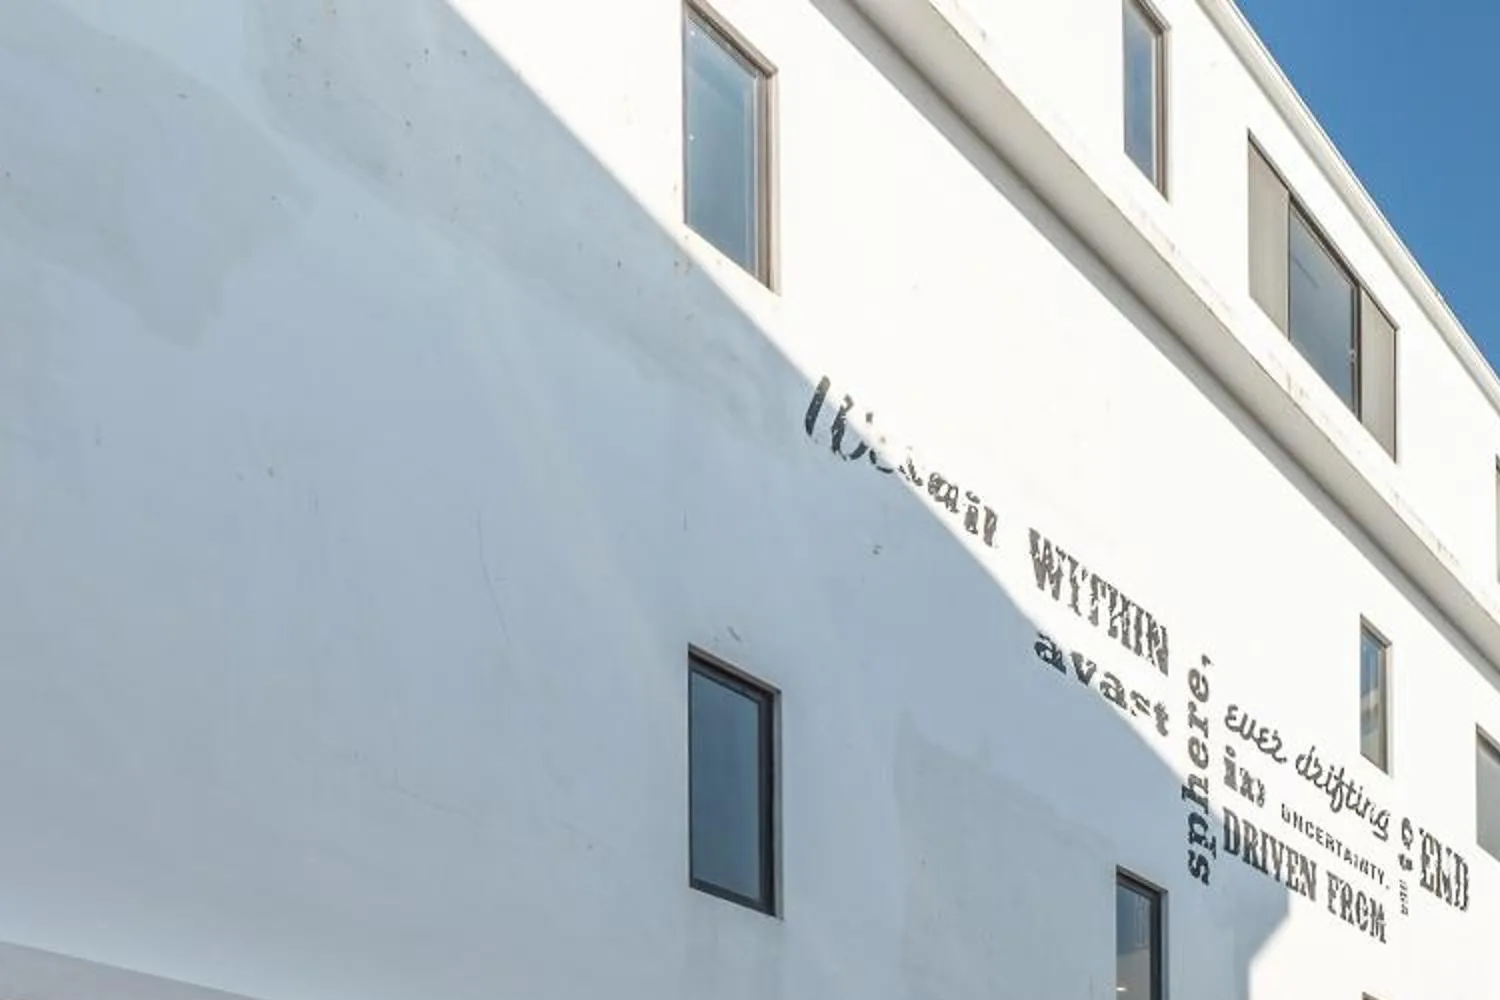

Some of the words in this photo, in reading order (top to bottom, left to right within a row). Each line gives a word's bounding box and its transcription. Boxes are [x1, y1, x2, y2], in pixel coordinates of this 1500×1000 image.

[1295, 745, 1390, 842] drifting
[1222, 806, 1317, 902] DRIVEN
[1326, 870, 1387, 944] FROM
